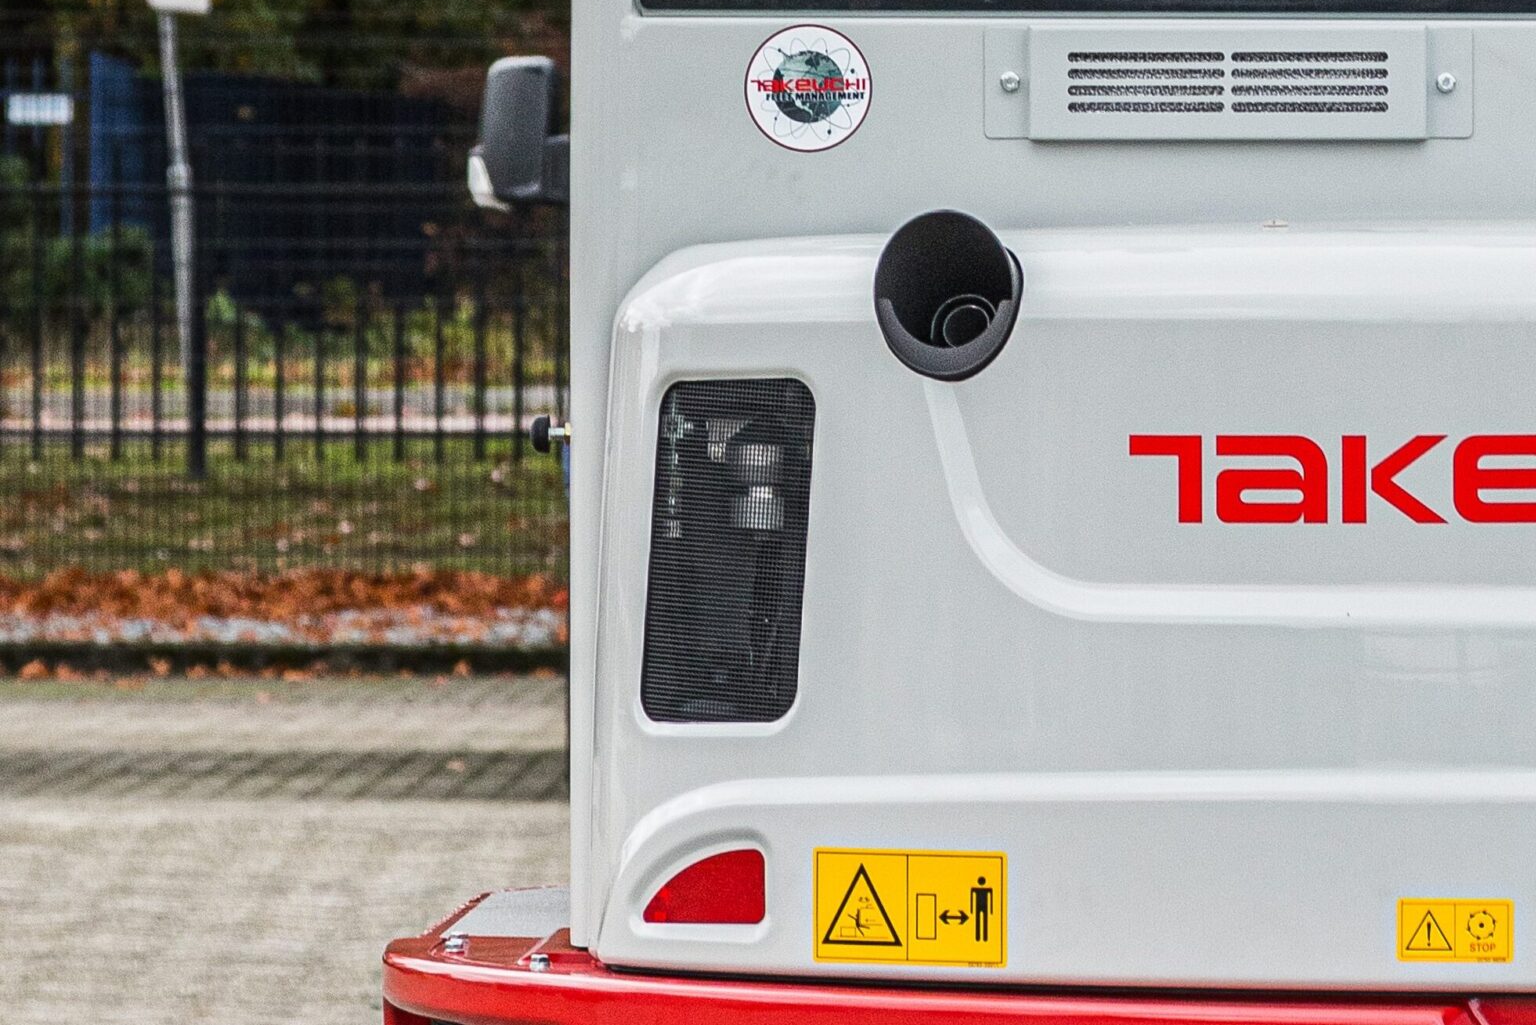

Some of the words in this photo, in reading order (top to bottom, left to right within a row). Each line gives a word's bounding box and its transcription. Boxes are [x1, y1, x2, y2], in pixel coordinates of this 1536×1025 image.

[766, 92, 794, 101] FLEET
[796, 92, 865, 101] MANAGEMENT
[1469, 943, 1496, 953] STOP
